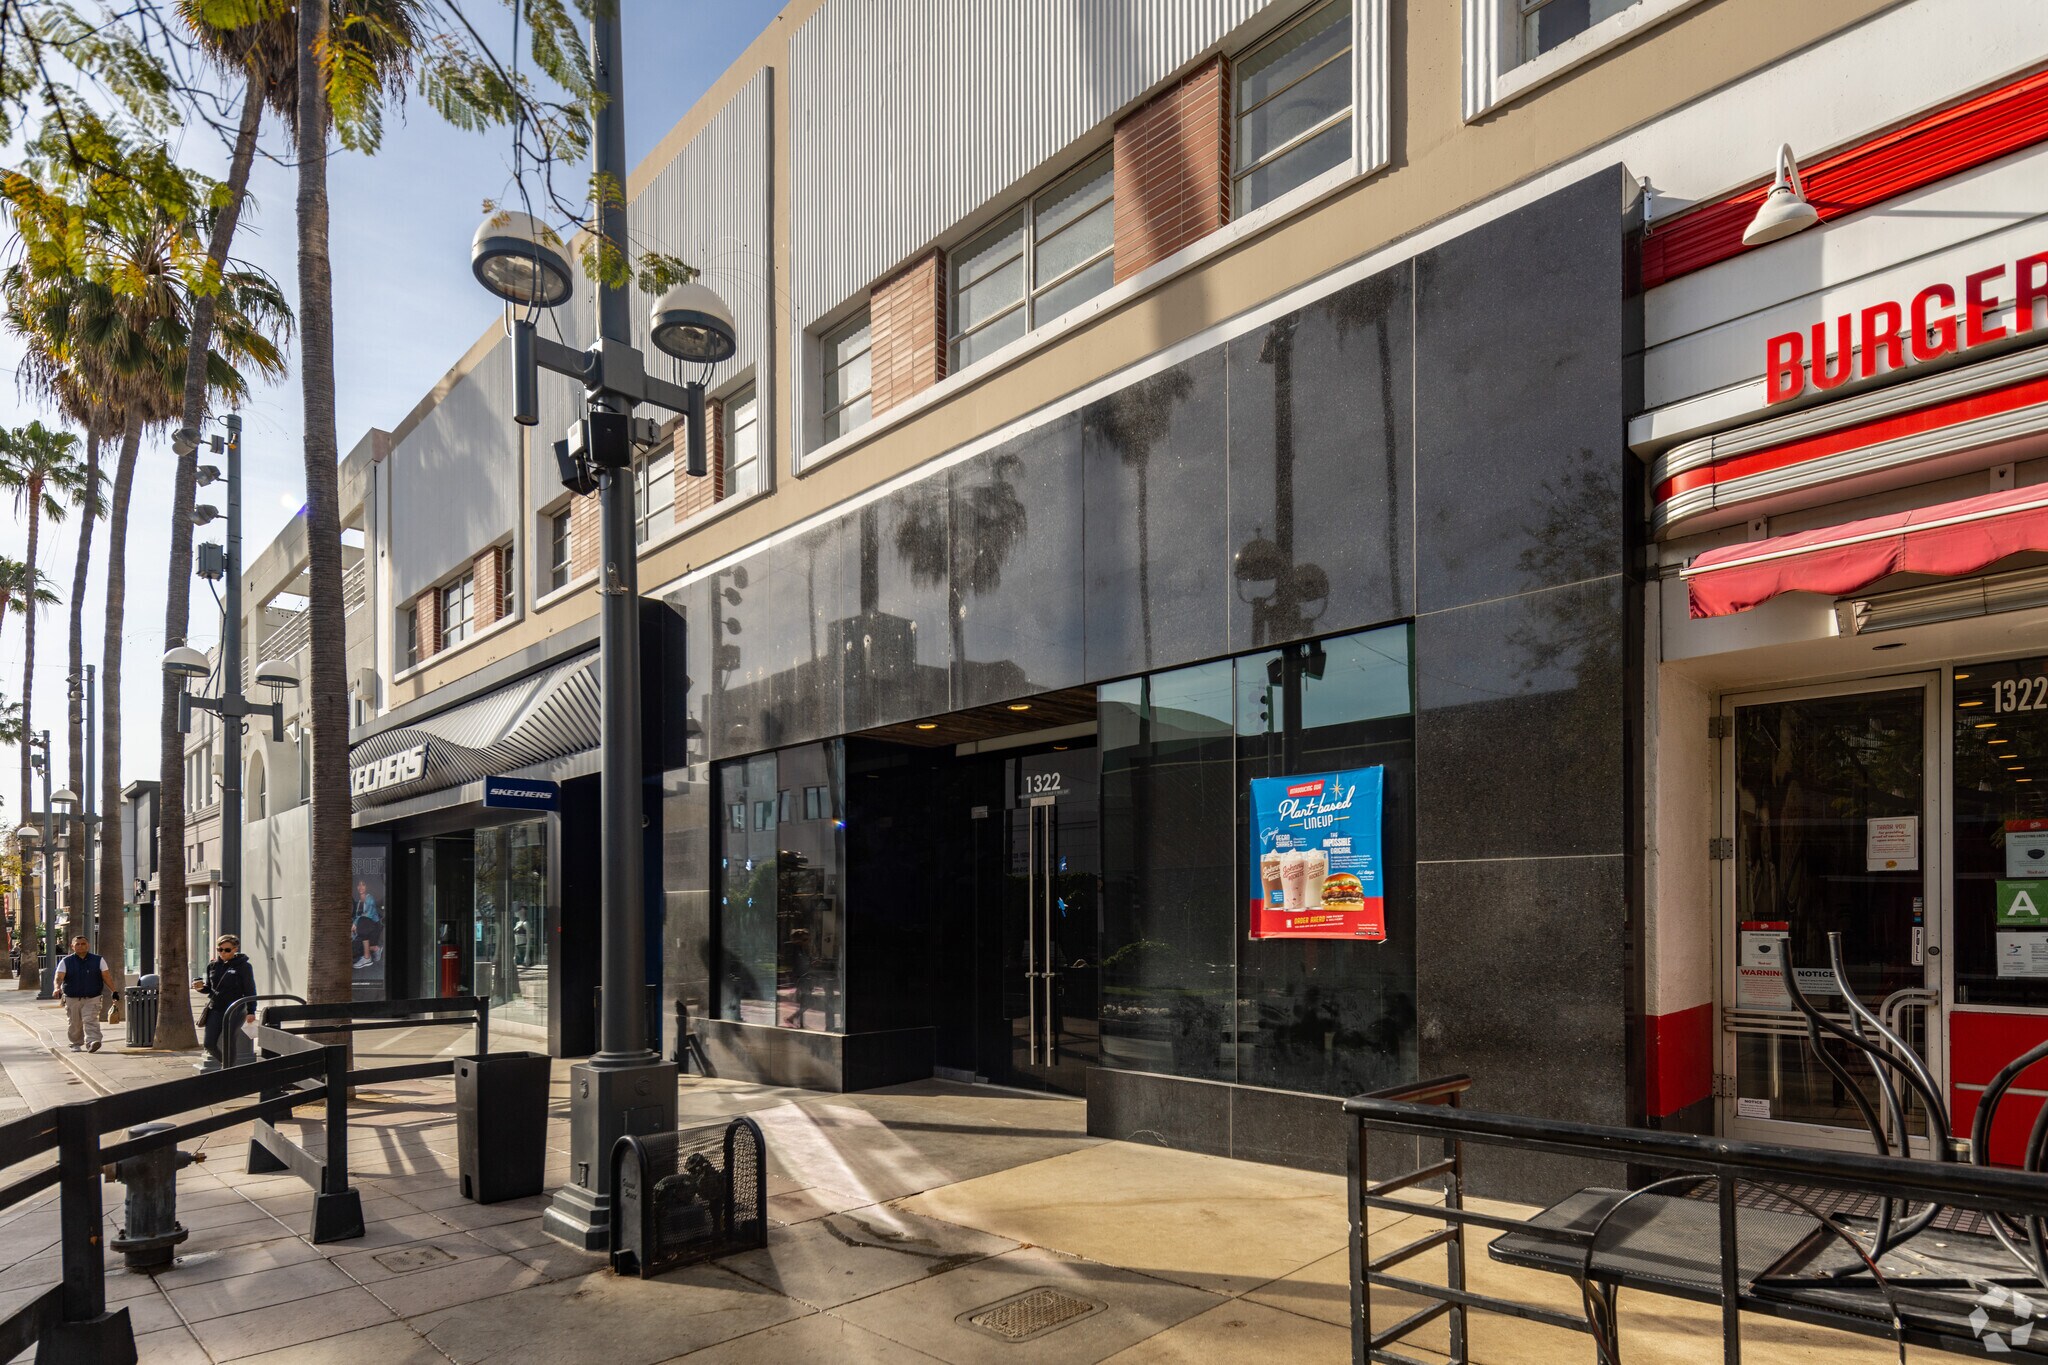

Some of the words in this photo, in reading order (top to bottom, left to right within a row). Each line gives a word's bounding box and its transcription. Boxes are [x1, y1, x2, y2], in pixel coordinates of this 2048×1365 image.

[1767, 251, 2048, 406] BURGER
[1992, 676, 2048, 713] 1322
[490, 788, 552, 799] SKECHERS
[1026, 772, 1060, 793] 1322
[1278, 785, 1356, 821] Plant-based
[1304, 814, 1334, 830] LINEUP
[2008, 890, 2040, 915] A
